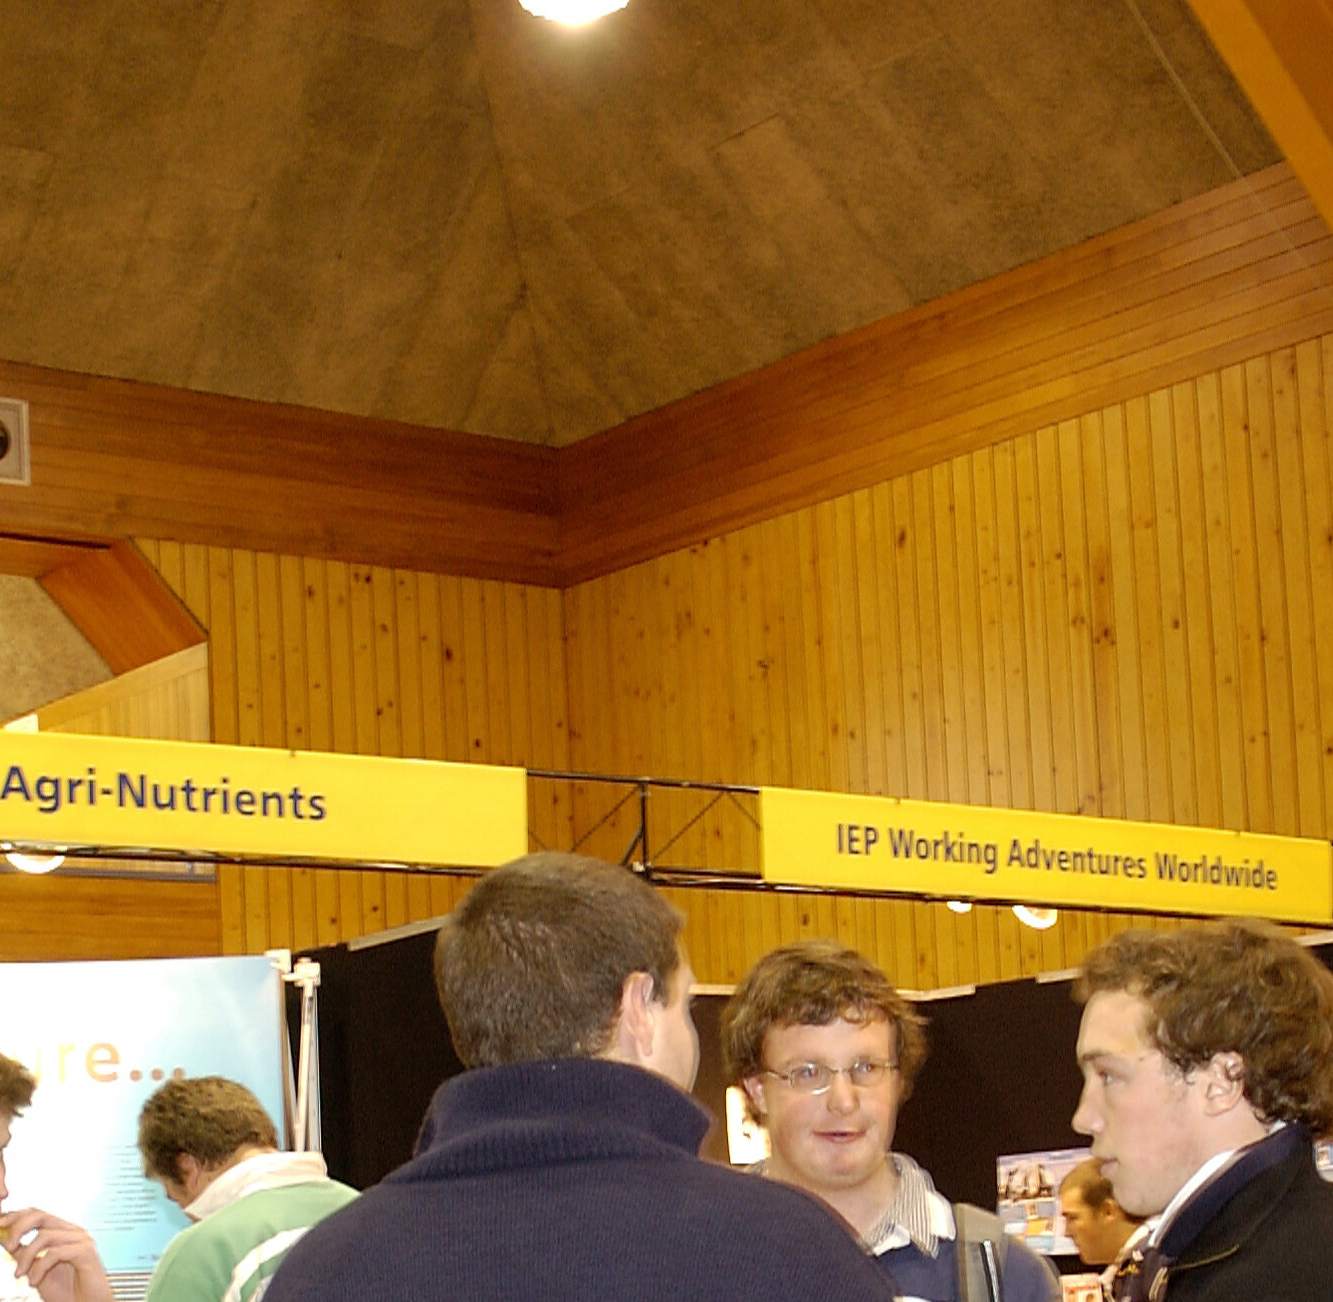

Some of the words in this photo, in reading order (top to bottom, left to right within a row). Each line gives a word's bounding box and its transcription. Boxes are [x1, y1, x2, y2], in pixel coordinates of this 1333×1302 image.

[0, 765, 327, 822] Agri-Nutrients
[837, 823, 879, 856] IEP
[888, 828, 998, 875] Working
[1007, 839, 1147, 880] Adventures
[1155, 853, 1279, 891] Worldwide
